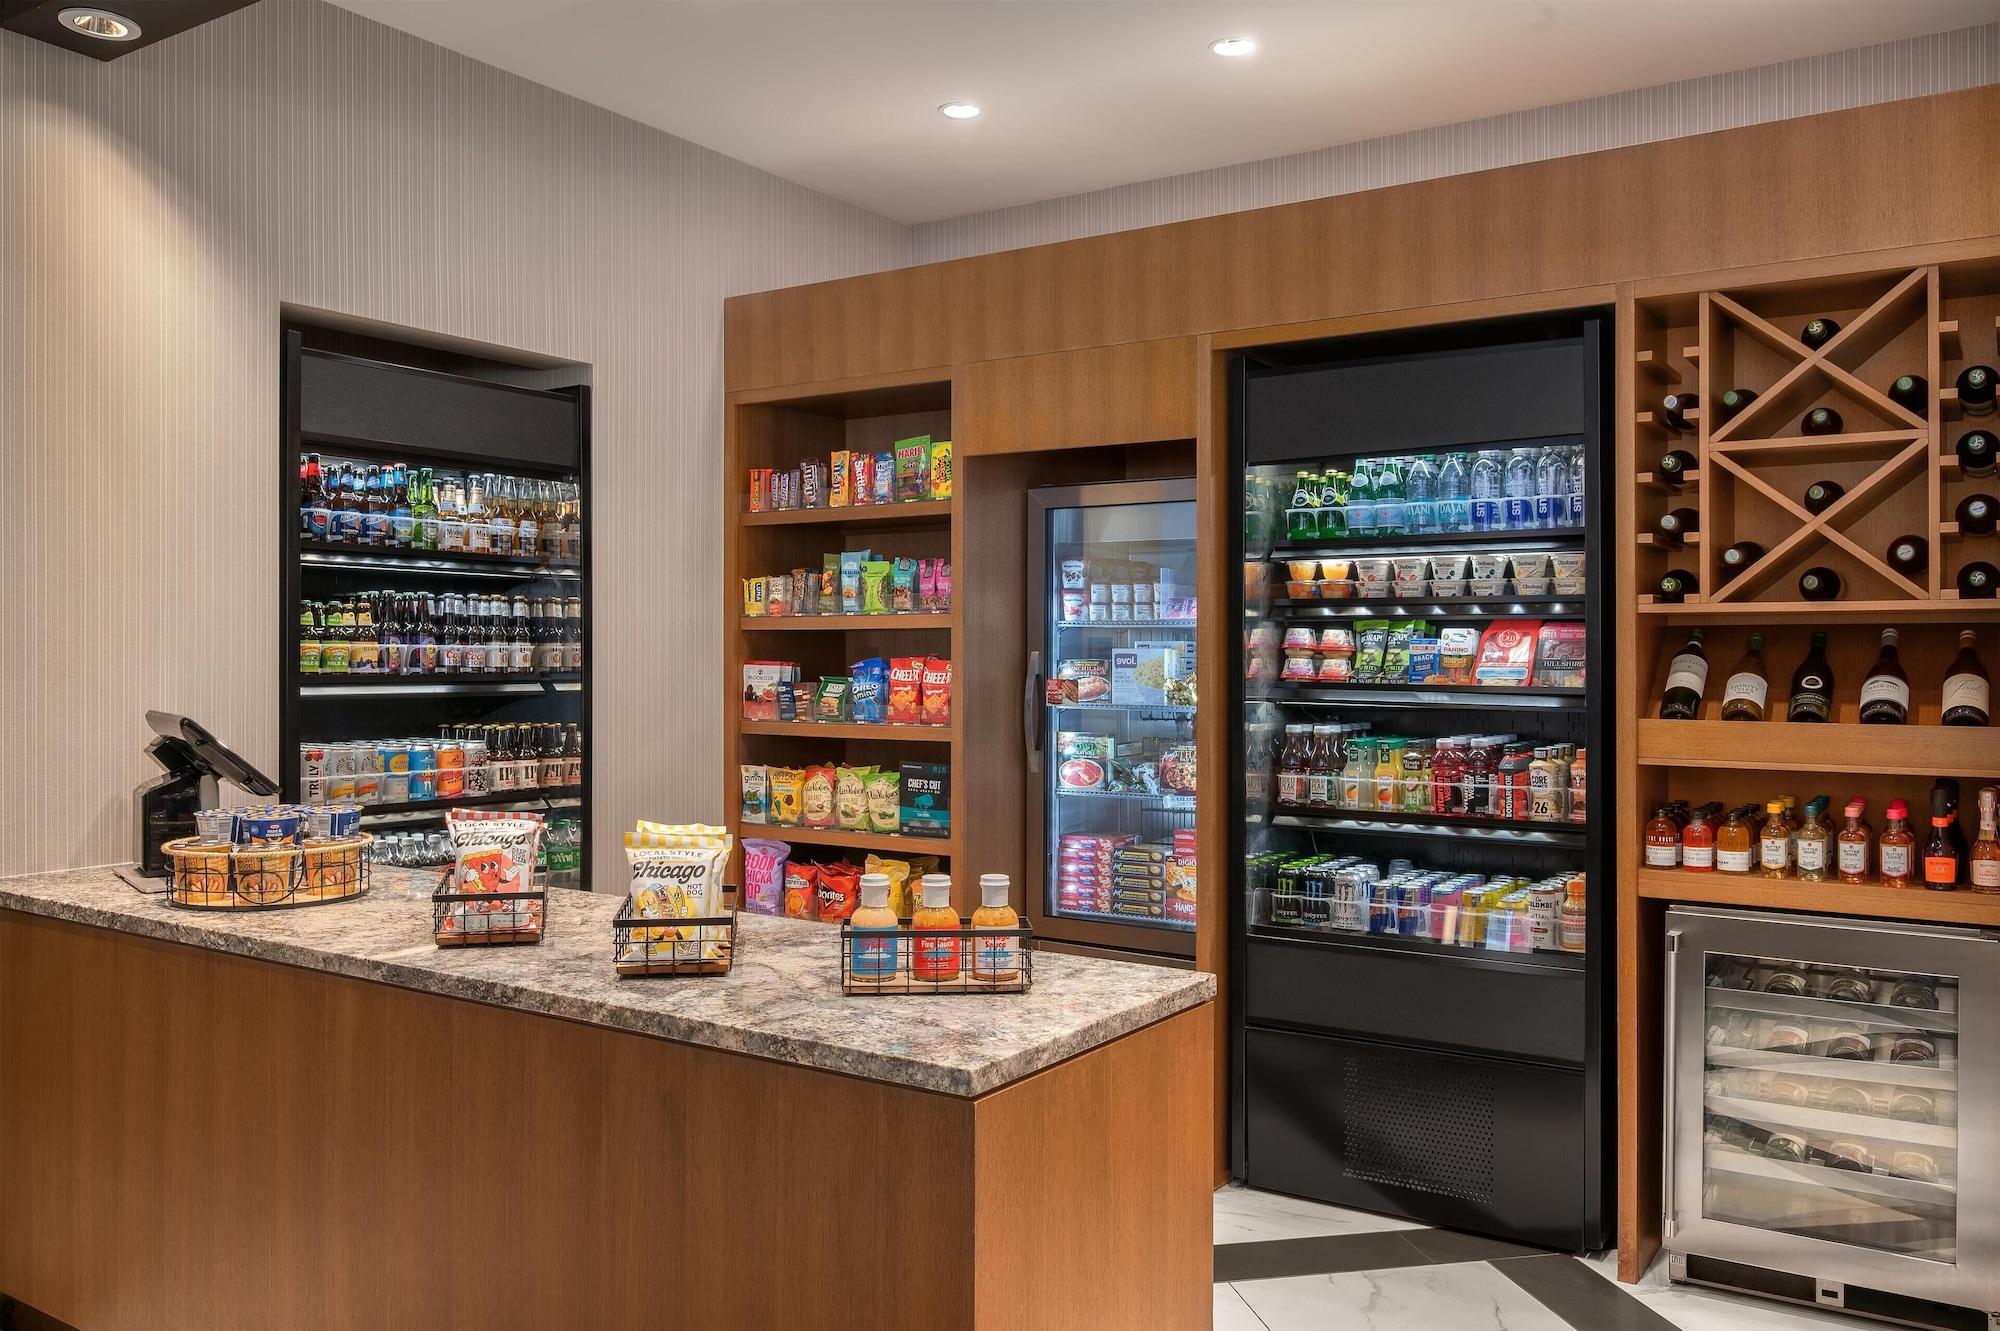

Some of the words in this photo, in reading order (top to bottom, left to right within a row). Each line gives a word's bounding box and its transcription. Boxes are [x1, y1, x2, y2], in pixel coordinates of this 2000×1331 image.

[898, 446, 926, 459] HARIBO
[855, 460, 865, 499] Skittles
[1440, 503, 1467, 514] DASAN
[1116, 655, 1136, 665] evol.
[1413, 654, 1434, 662] SNACK
[852, 682, 879, 694] OREO
[857, 690, 875, 700] mini
[309, 765, 319, 798] TRULY
[744, 775, 764, 784] gimme
[907, 778, 929, 789] CHEF'S
[929, 780, 941, 790] CUT
[1531, 775, 1548, 785] CORE
[456, 832, 526, 849] Chicago
[633, 850, 665, 858] LOCAL
[669, 850, 704, 858] STYLE
[745, 852, 777, 871] BOOM
[633, 860, 706, 884] Chicago
[818, 889, 845, 902] Doritos
[921, 940, 934, 948] Fire
